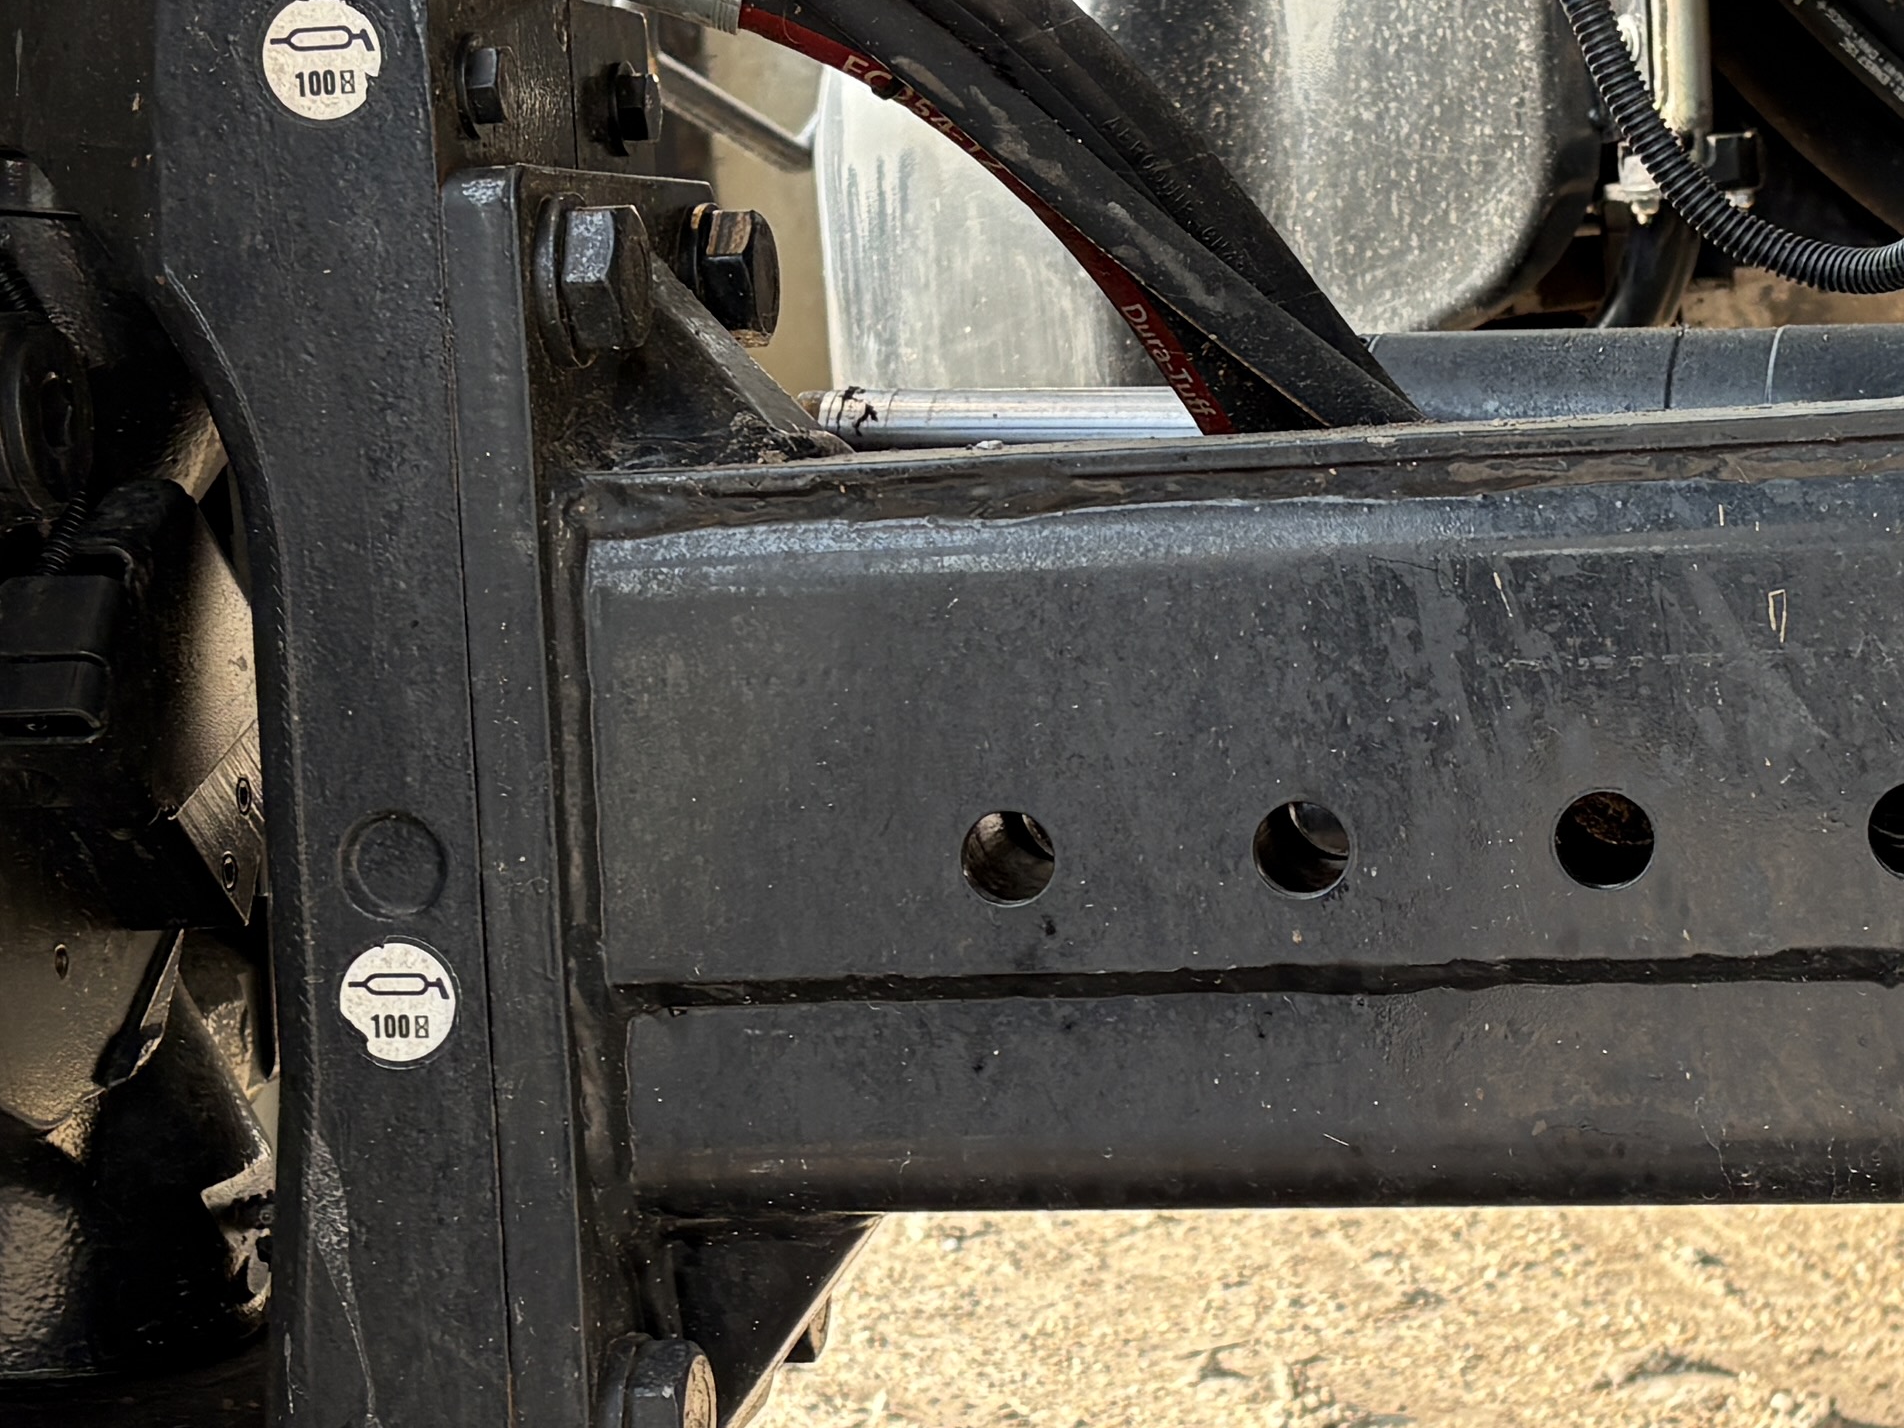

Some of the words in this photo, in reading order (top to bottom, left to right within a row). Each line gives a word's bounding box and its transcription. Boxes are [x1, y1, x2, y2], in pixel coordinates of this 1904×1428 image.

[295, 69, 336, 97] 100
[1121, 303, 1216, 415] Dura-Tuff
[370, 1013, 410, 1039] 100
